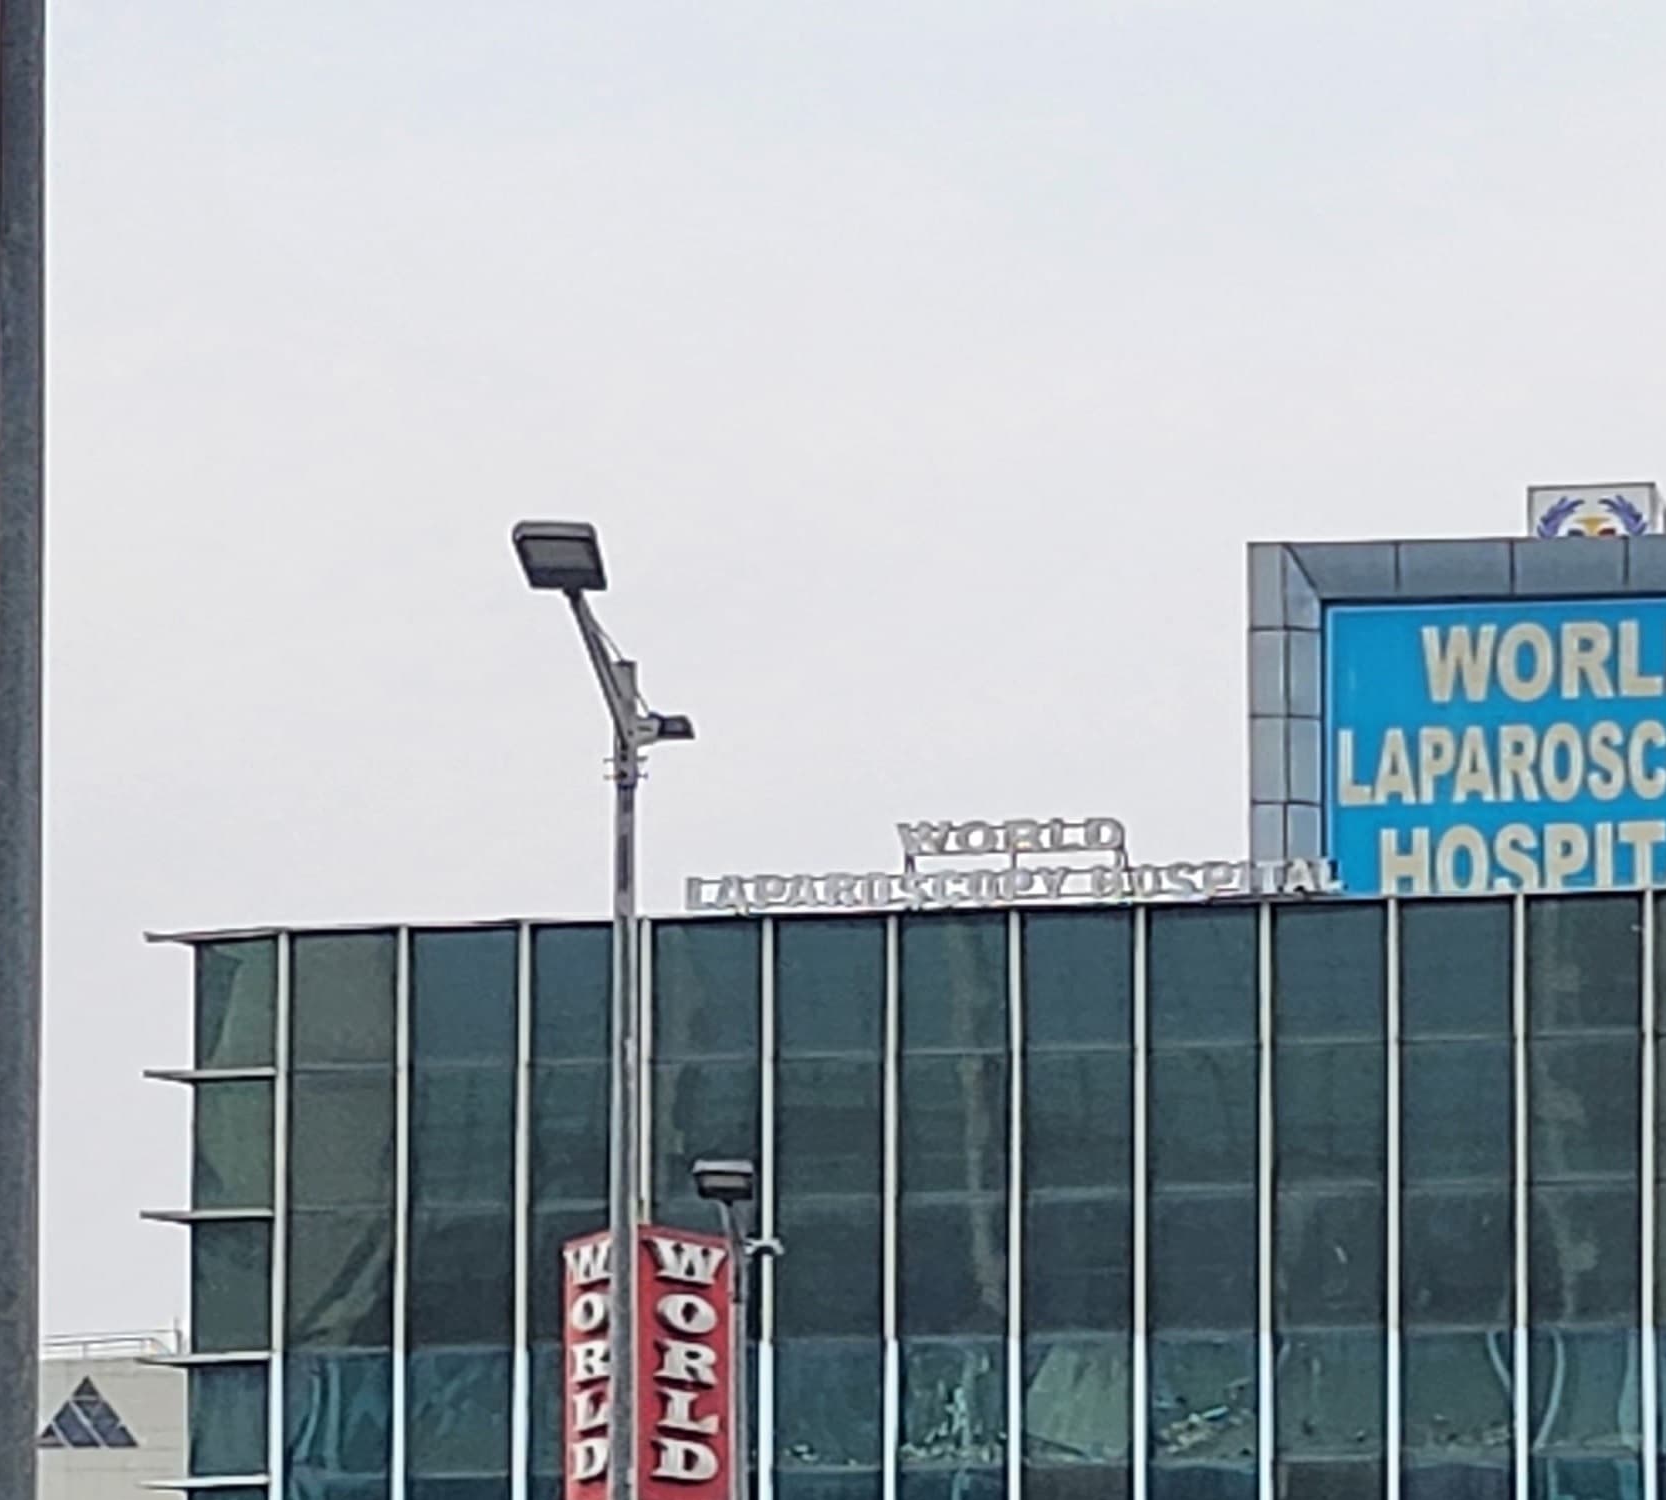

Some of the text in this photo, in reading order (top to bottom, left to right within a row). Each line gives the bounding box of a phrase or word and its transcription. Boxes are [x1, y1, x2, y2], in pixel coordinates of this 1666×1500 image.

[896, 818, 1125, 856] WORLD
[685, 856, 1346, 910] LAPAROSCOPY HOSPITAL
[649, 1236, 728, 1482] WORLD
